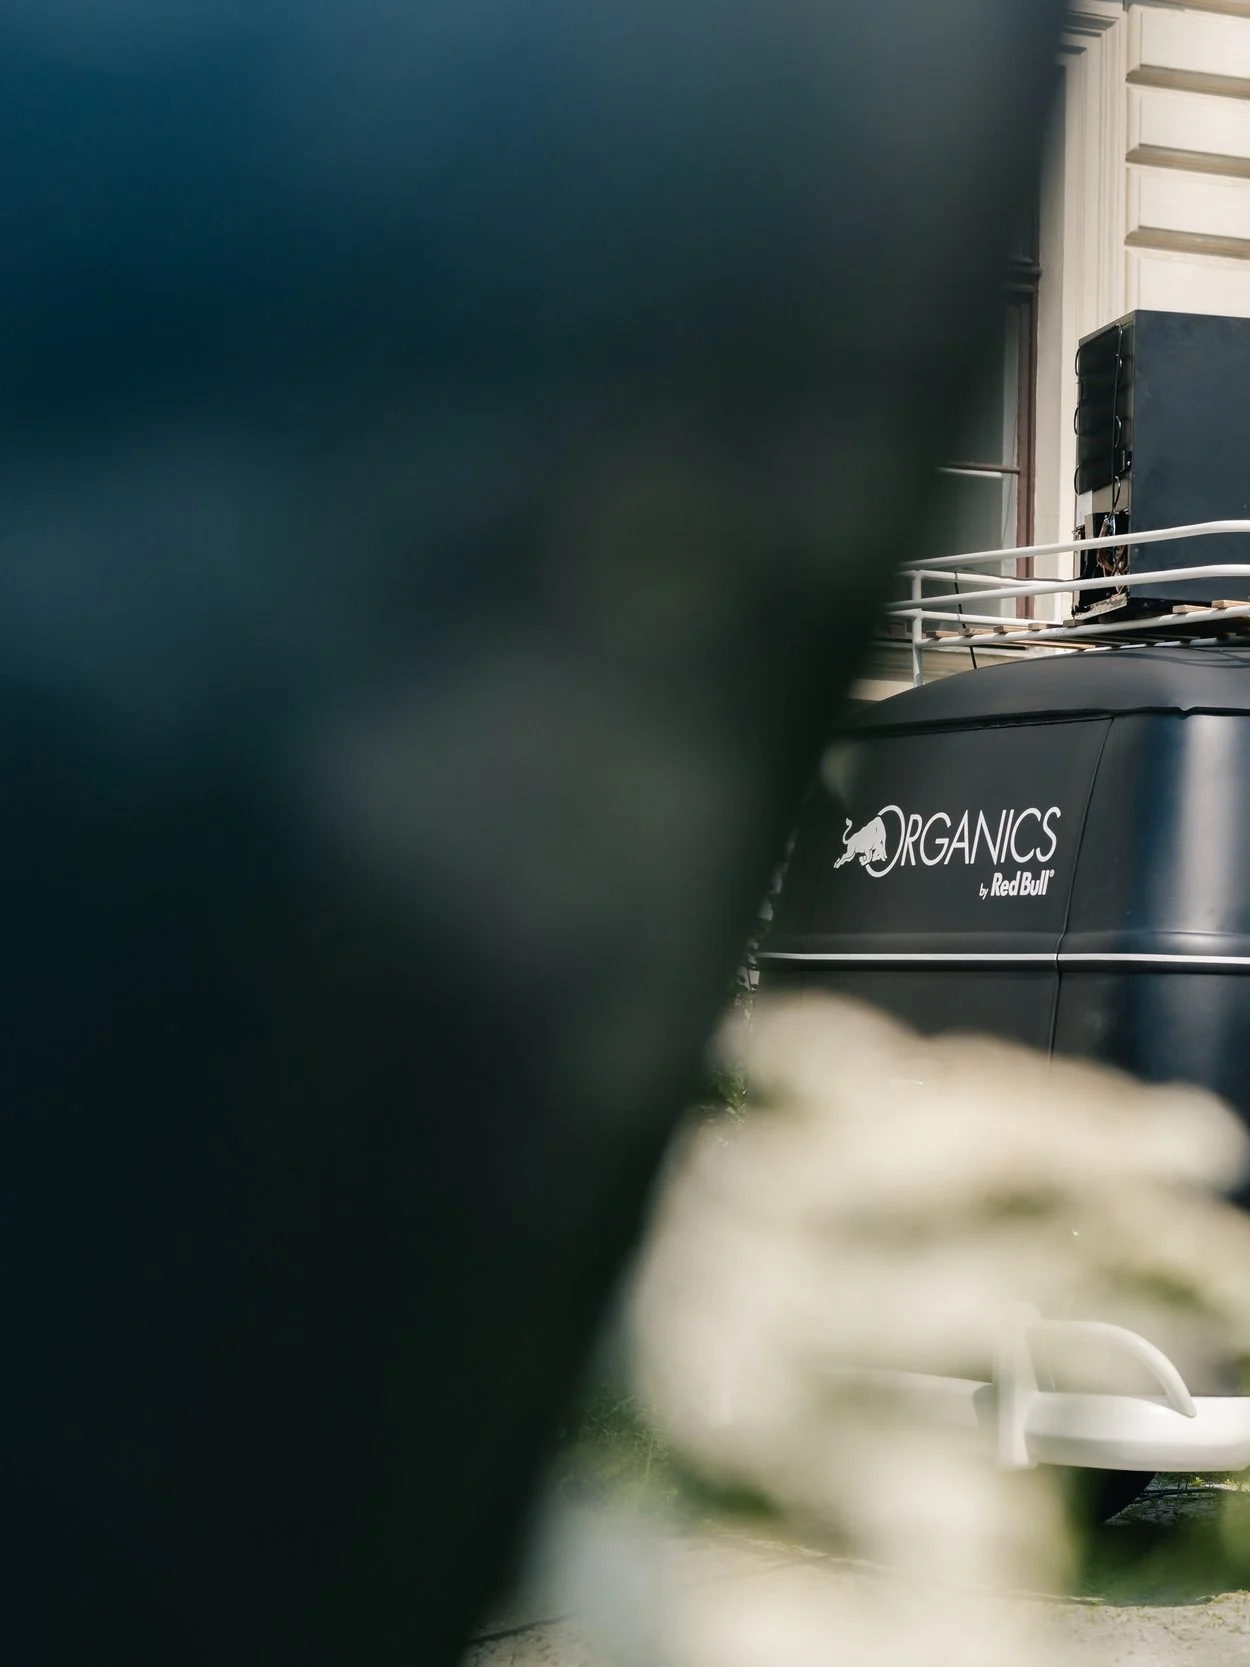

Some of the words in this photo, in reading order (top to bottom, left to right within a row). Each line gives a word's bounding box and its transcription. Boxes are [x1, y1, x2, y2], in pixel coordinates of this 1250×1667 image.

[865, 804, 1062, 878] ORGANICS
[979, 882, 989, 900] by
[990, 870, 1022, 896] Red
